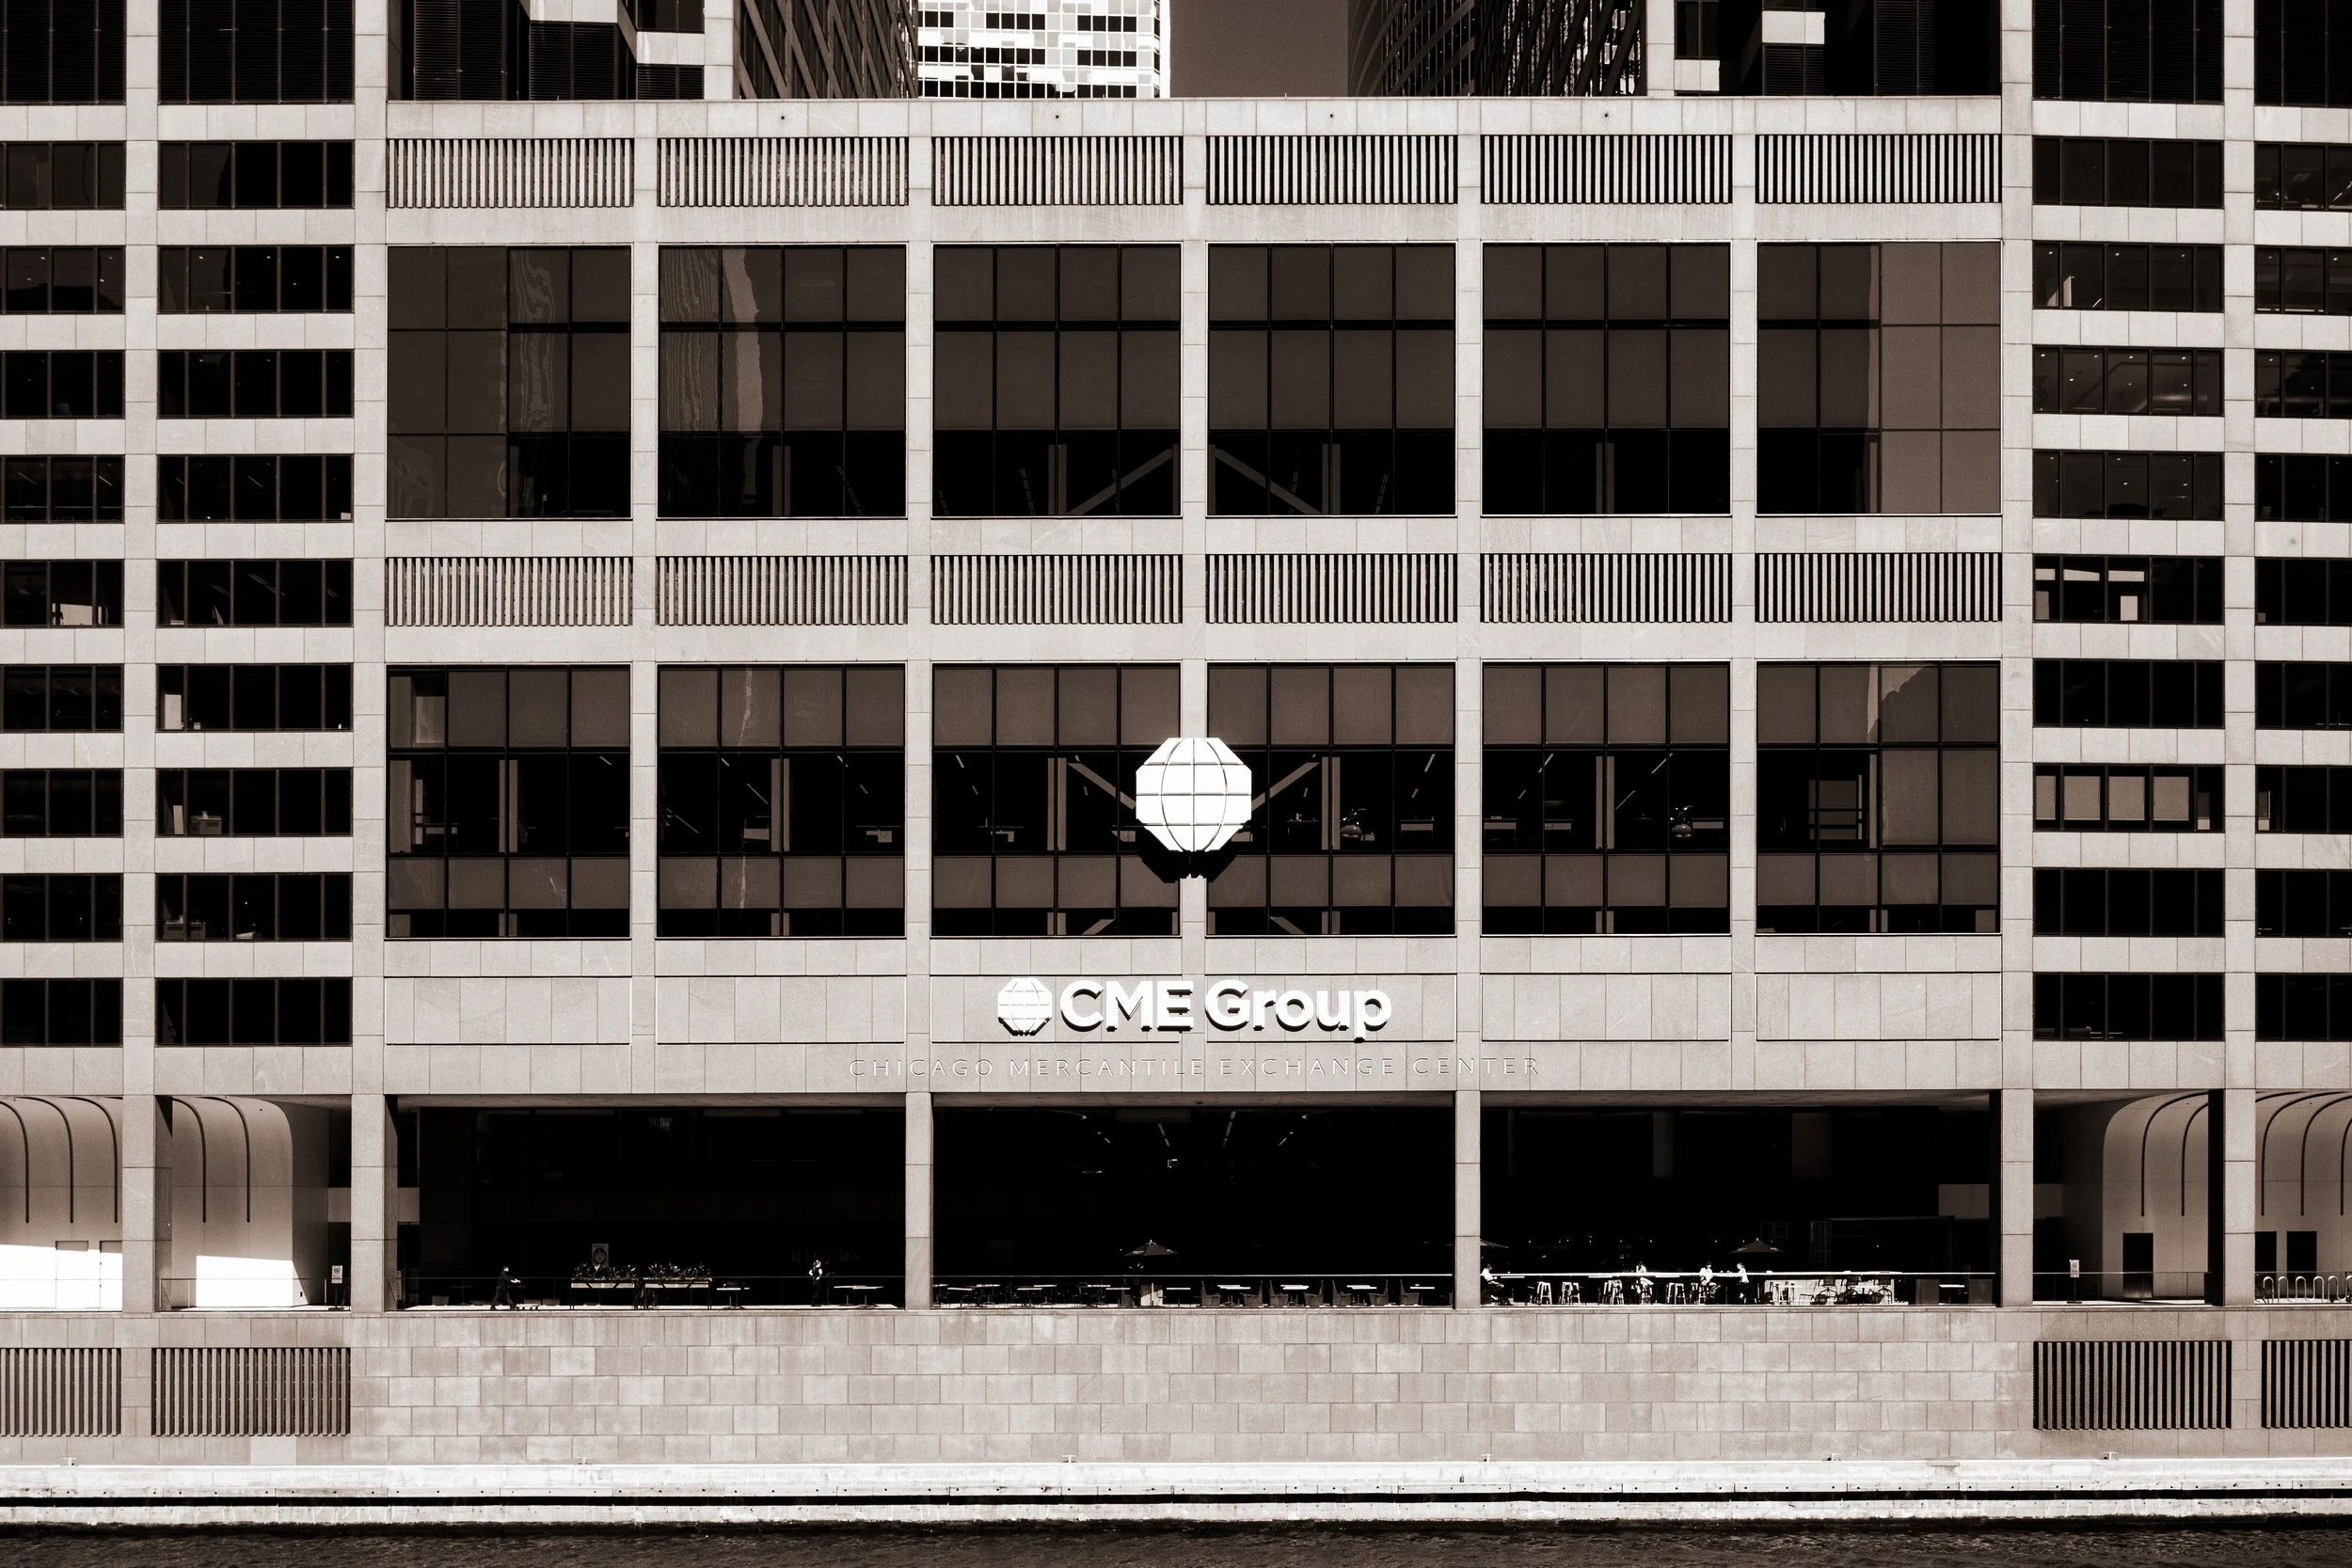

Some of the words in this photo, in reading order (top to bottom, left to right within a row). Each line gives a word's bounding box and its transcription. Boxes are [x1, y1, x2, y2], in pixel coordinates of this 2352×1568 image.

[1060, 979, 1194, 1029] CME
[1205, 979, 1392, 1040] Group
[849, 1058, 993, 1076] CHICAGO
[1009, 1058, 1204, 1076] MERCANTILE
[1220, 1057, 1394, 1075] EXCHANGE
[1413, 1057, 1539, 1075] CENTER
